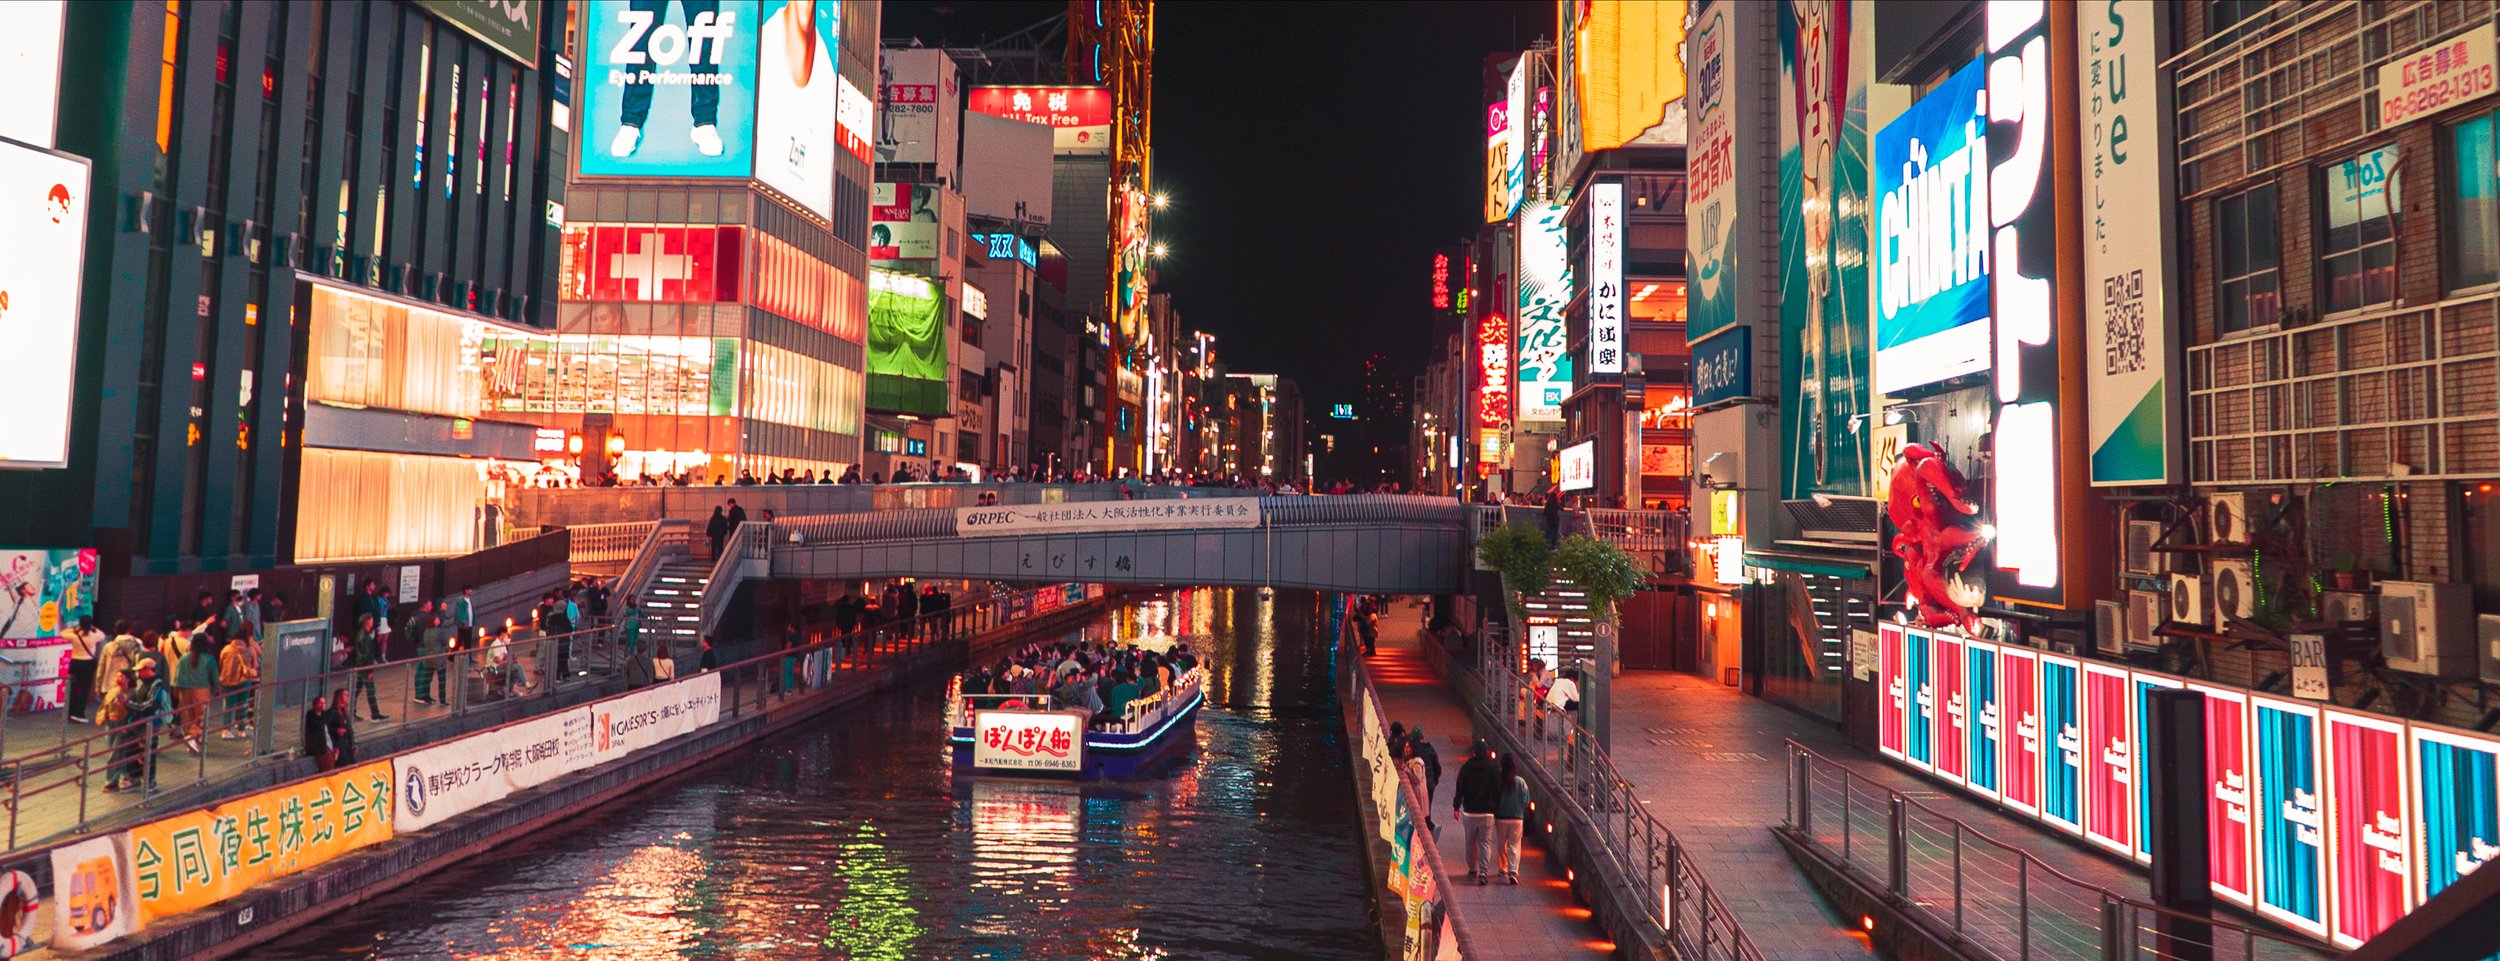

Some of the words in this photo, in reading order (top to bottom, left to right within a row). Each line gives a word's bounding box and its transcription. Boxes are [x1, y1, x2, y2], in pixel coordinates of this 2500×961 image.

[610, 10, 734, 66] Zoff
[609, 69, 638, 86] Eye
[638, 69, 733, 86] Performance
[1809, 17, 1822, 138] グリコ
[2402, 40, 2469, 88] 広告募集
[878, 86, 935, 101] 告募集
[1013, 92, 1068, 111] 免税
[2384, 63, 2493, 124] 06-6262-1313
[1051, 114, 1079, 125] Free
[2090, 31, 2107, 254] に変わりました。
[1689, 129, 1733, 205] 毎日骨太
[1701, 200, 1721, 256] MBP
[1024, 508, 1098, 523] 一般社団法人
[1102, 504, 1249, 519] 大阪活性化事業実行委員会
[1021, 553, 1132, 573] えびす橋
[2292, 640, 2326, 668] BAR
[983, 725, 1071, 757] ぽんぽん船
